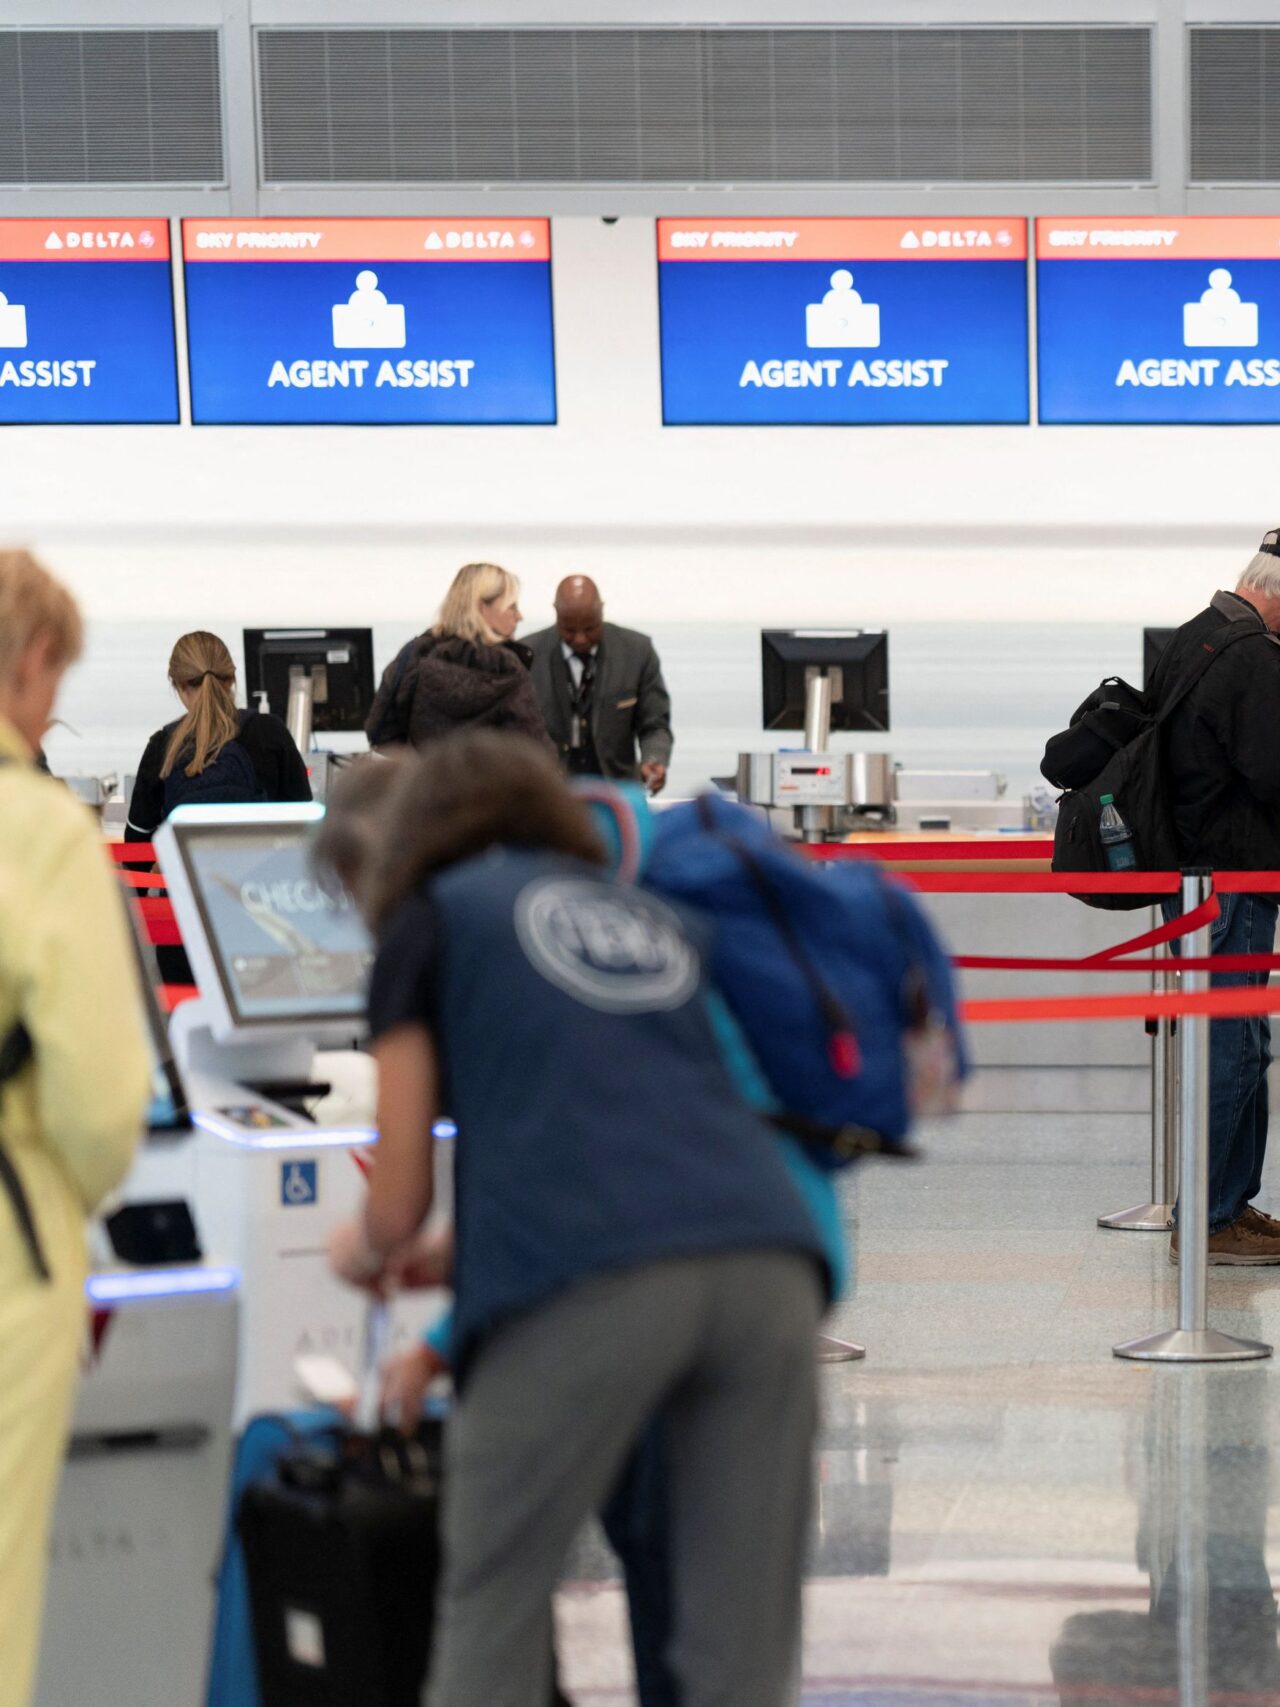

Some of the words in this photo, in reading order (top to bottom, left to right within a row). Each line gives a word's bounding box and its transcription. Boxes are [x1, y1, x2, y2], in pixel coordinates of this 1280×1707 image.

[66, 232, 134, 248] DELTA
[236, 232, 322, 249] PRIORITY
[445, 231, 515, 249] DELTA
[711, 231, 799, 248] PRIORITY
[921, 230, 992, 247] DELTA
[1090, 230, 1179, 247] PRIORITY
[0, 360, 97, 387] ASSIST
[268, 359, 370, 388] AGENT
[375, 359, 475, 388] ASSIST
[739, 359, 843, 388] AGENT
[847, 359, 949, 388] ASSIST
[1115, 358, 1221, 387] AGENT
